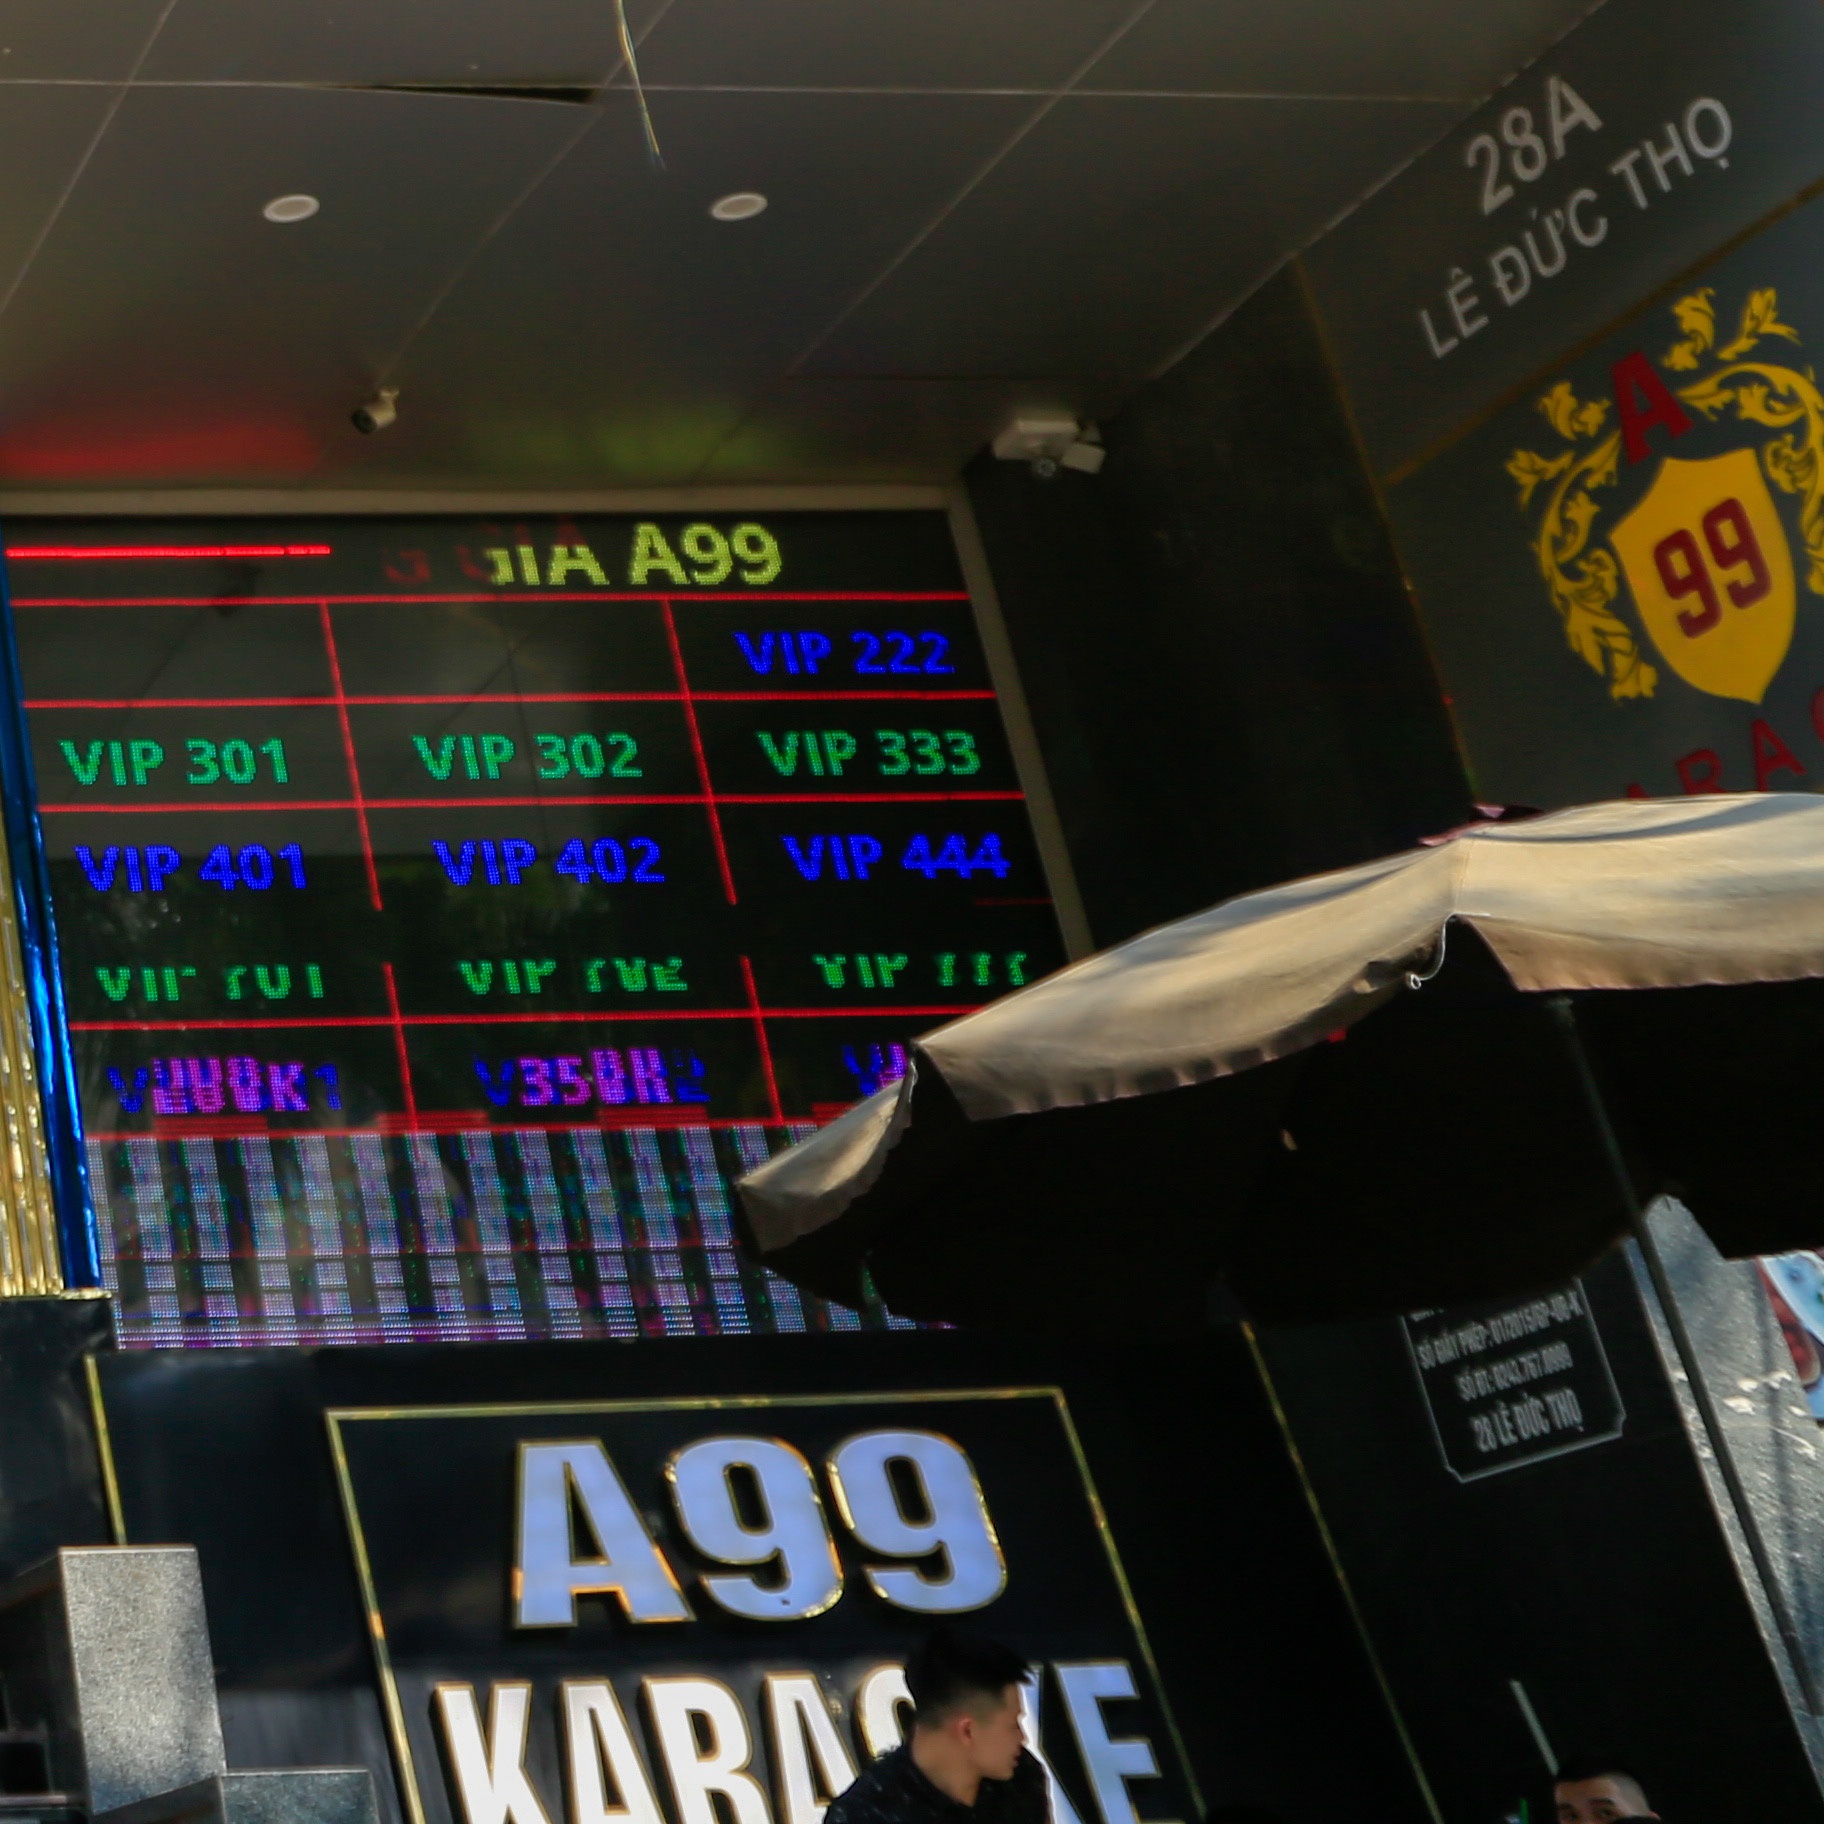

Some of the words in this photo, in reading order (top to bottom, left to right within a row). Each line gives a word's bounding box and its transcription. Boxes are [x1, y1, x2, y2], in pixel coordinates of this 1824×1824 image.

[1463, 74, 1603, 216] 28A
[1419, 266, 1489, 360] LÊ
[1491, 187, 1610, 308] ĐỨC
[1611, 96, 1735, 210] THỌ
[629, 522, 782, 585] A99
[1652, 496, 1773, 640] 99
[734, 631, 832, 675] VIP
[850, 630, 955, 675] 222
[59, 739, 164, 785] VIP
[186, 738, 288, 785] 301
[412, 734, 515, 780] VIP
[534, 733, 643, 779] 302
[758, 732, 856, 776] VIP
[877, 731, 981, 775] 333
[74, 844, 181, 892] VIP
[198, 842, 307, 891] 401
[431, 837, 537, 885] VIP
[554, 836, 666, 884] 402
[782, 834, 883, 880] VIP
[900, 832, 1012, 879] 444
[511, 1429, 1008, 1629] A99
[434, 1659, 1186, 1824] KARAE
